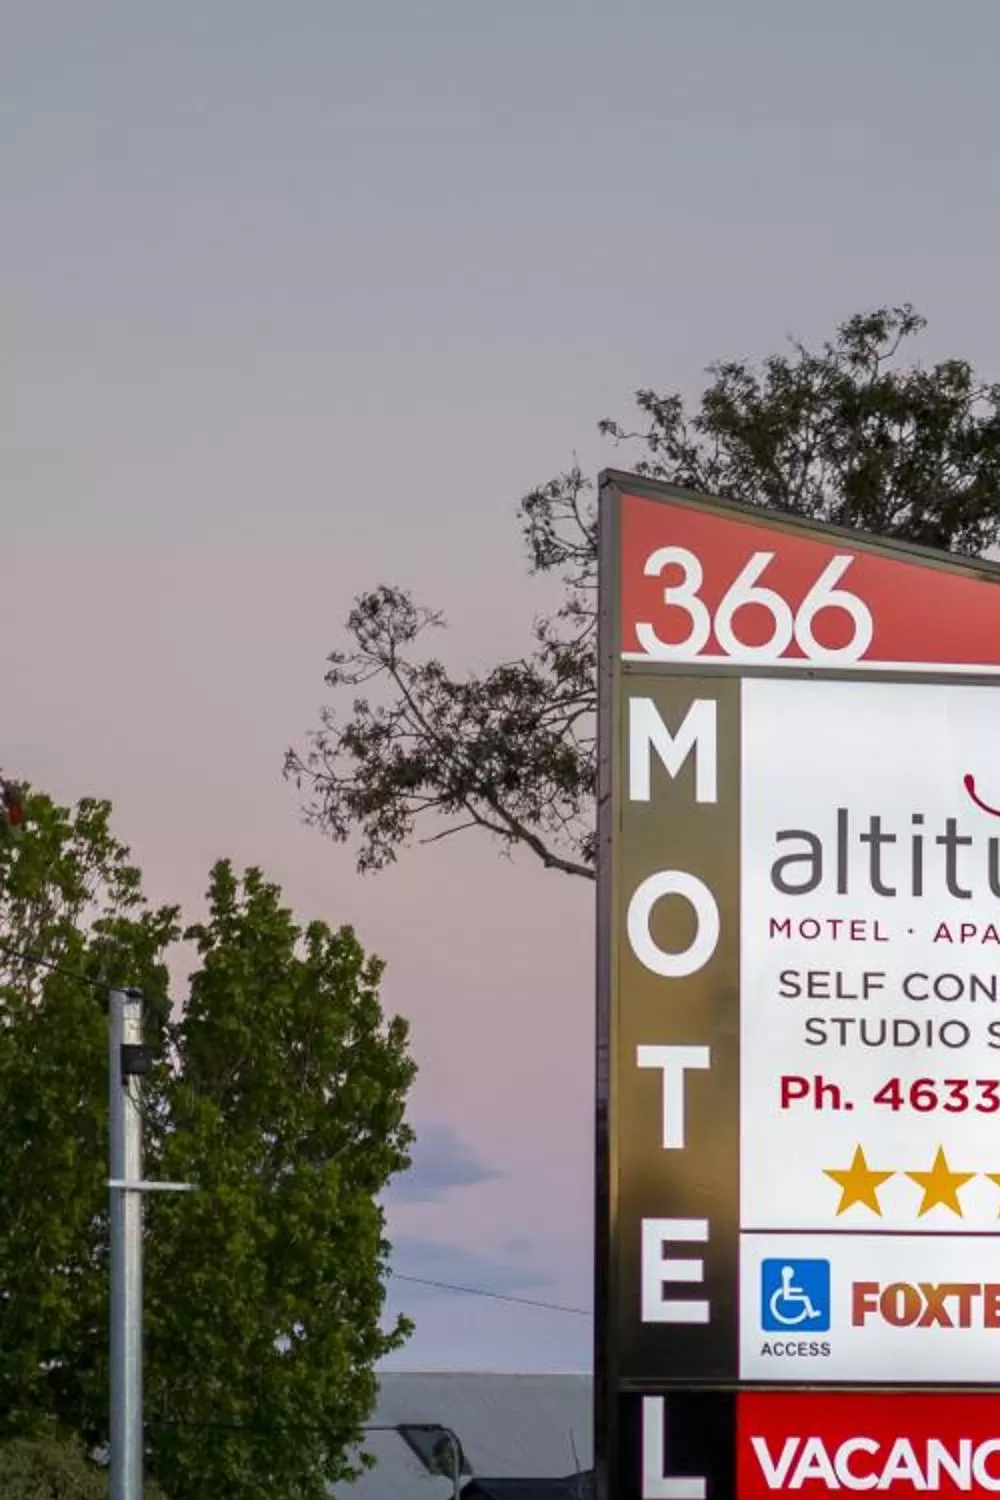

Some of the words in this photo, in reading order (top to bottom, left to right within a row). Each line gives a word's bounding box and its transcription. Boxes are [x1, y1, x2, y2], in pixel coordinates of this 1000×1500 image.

[634, 546, 874, 661] 366
[769, 917, 889, 943] MOTEL
[778, 970, 886, 1000] SELF
[804, 1017, 970, 1049] STUDIO
[627, 697, 721, 1500] MOTEL
[780, 1075, 854, 1111] Ph.
[873, 1077, 1000, 1113] 4633
[760, 1341, 832, 1358] ACCESS
